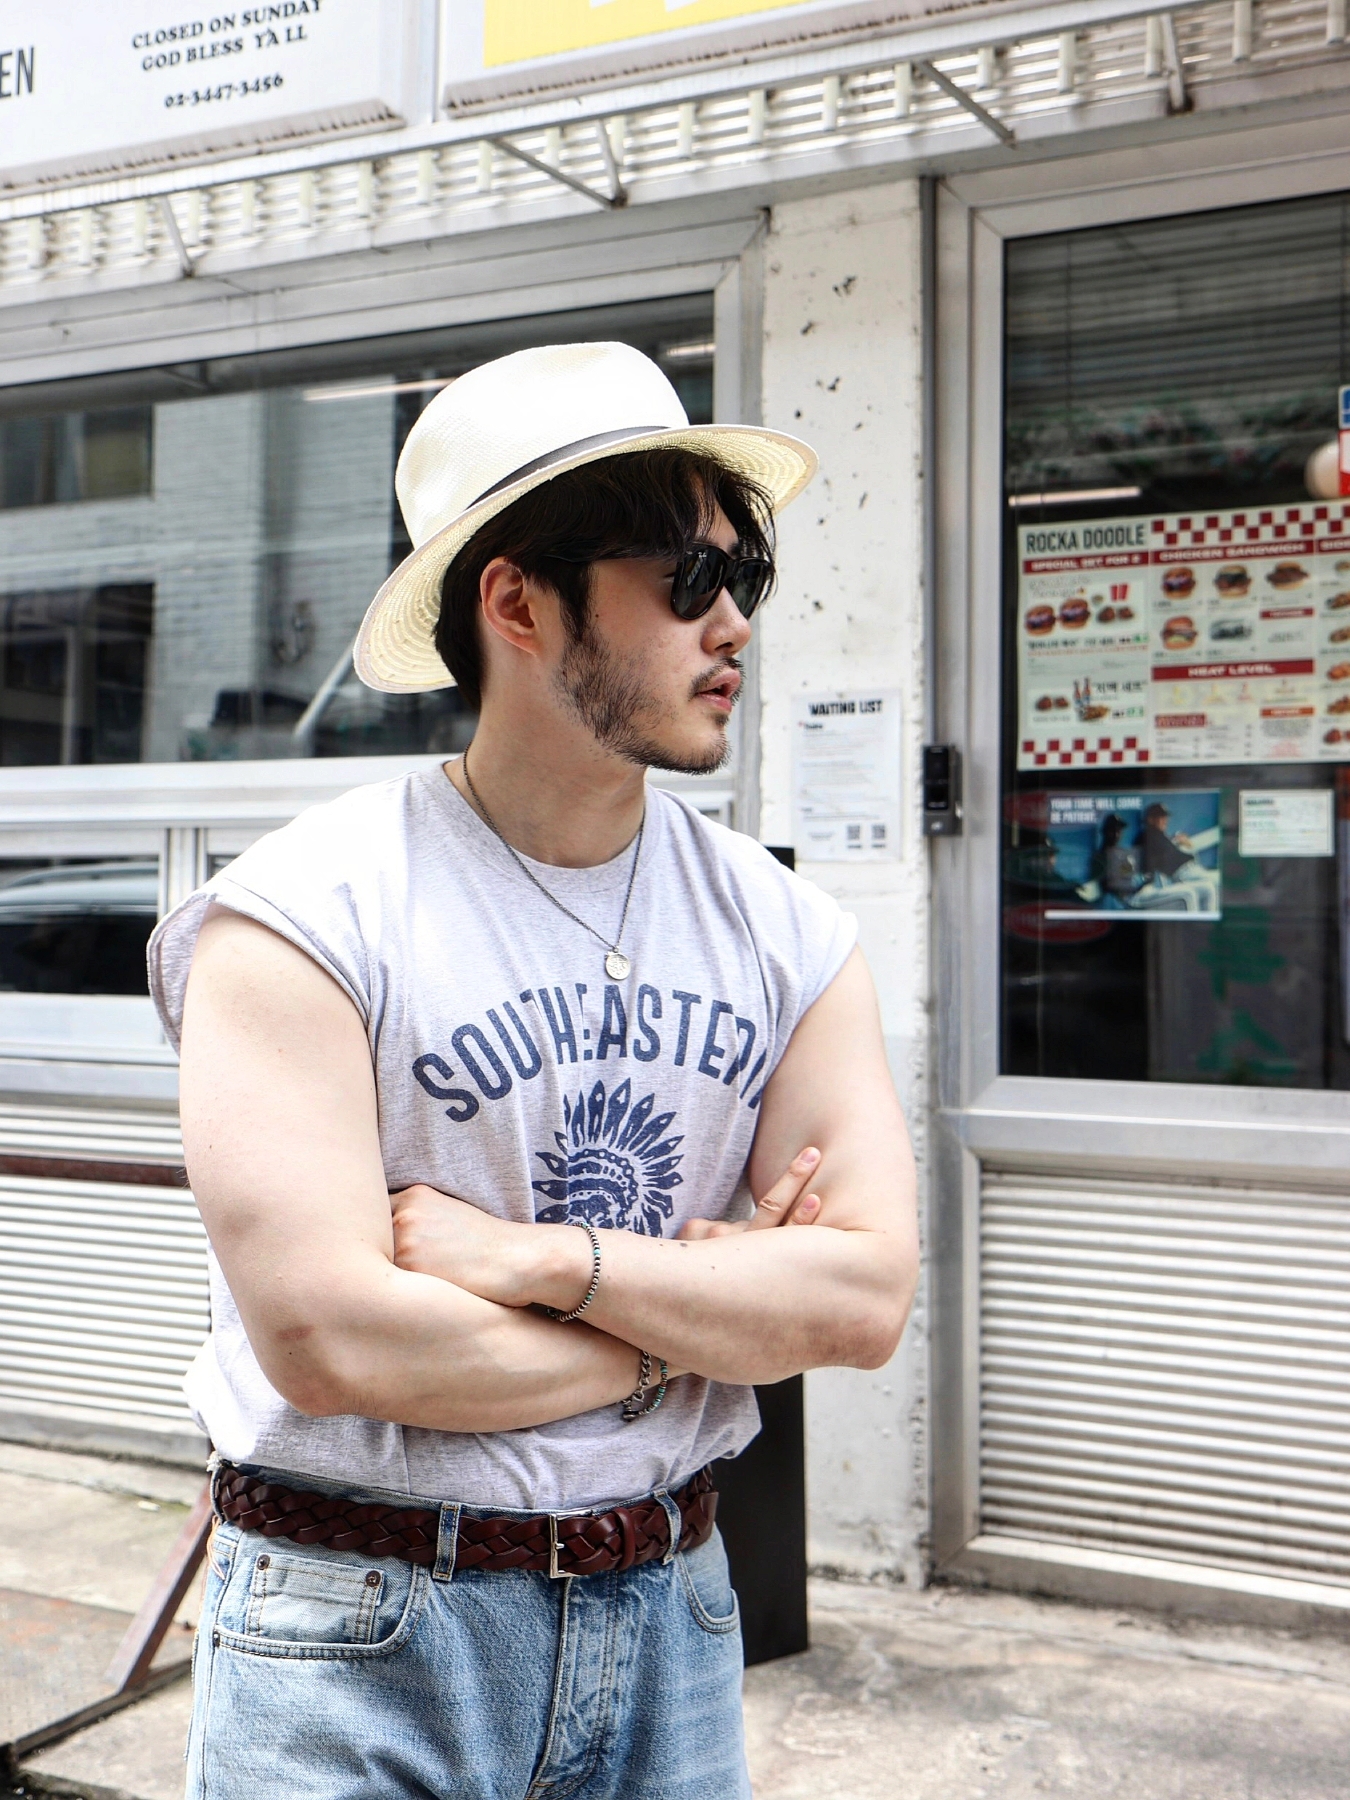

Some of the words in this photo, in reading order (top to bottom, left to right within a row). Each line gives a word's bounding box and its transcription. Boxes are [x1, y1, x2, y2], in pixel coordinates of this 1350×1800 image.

[132, 21, 204, 49] CLOSED
[210, 14, 236, 33] ON
[241, 0, 322, 26] SUNDAY
[142, 50, 181, 71] GOD
[187, 38, 244, 63] BLESS
[1026, 531, 1078, 553] ROCKA
[1083, 524, 1145, 549] DOODLE
[1159, 549, 1224, 562] CHICKEN
[1226, 543, 1306, 557] SANDWICH
[1188, 664, 1226, 677] HEAT
[1229, 662, 1275, 676] LEVEL
[808, 702, 855, 715] WAITING
[860, 700, 882, 713] LIST
[1051, 797, 1072, 810] YOUR
[1074, 797, 1093, 810] TIME
[1095, 797, 1115, 810] WILL
[1050, 811, 1060, 824] BE
